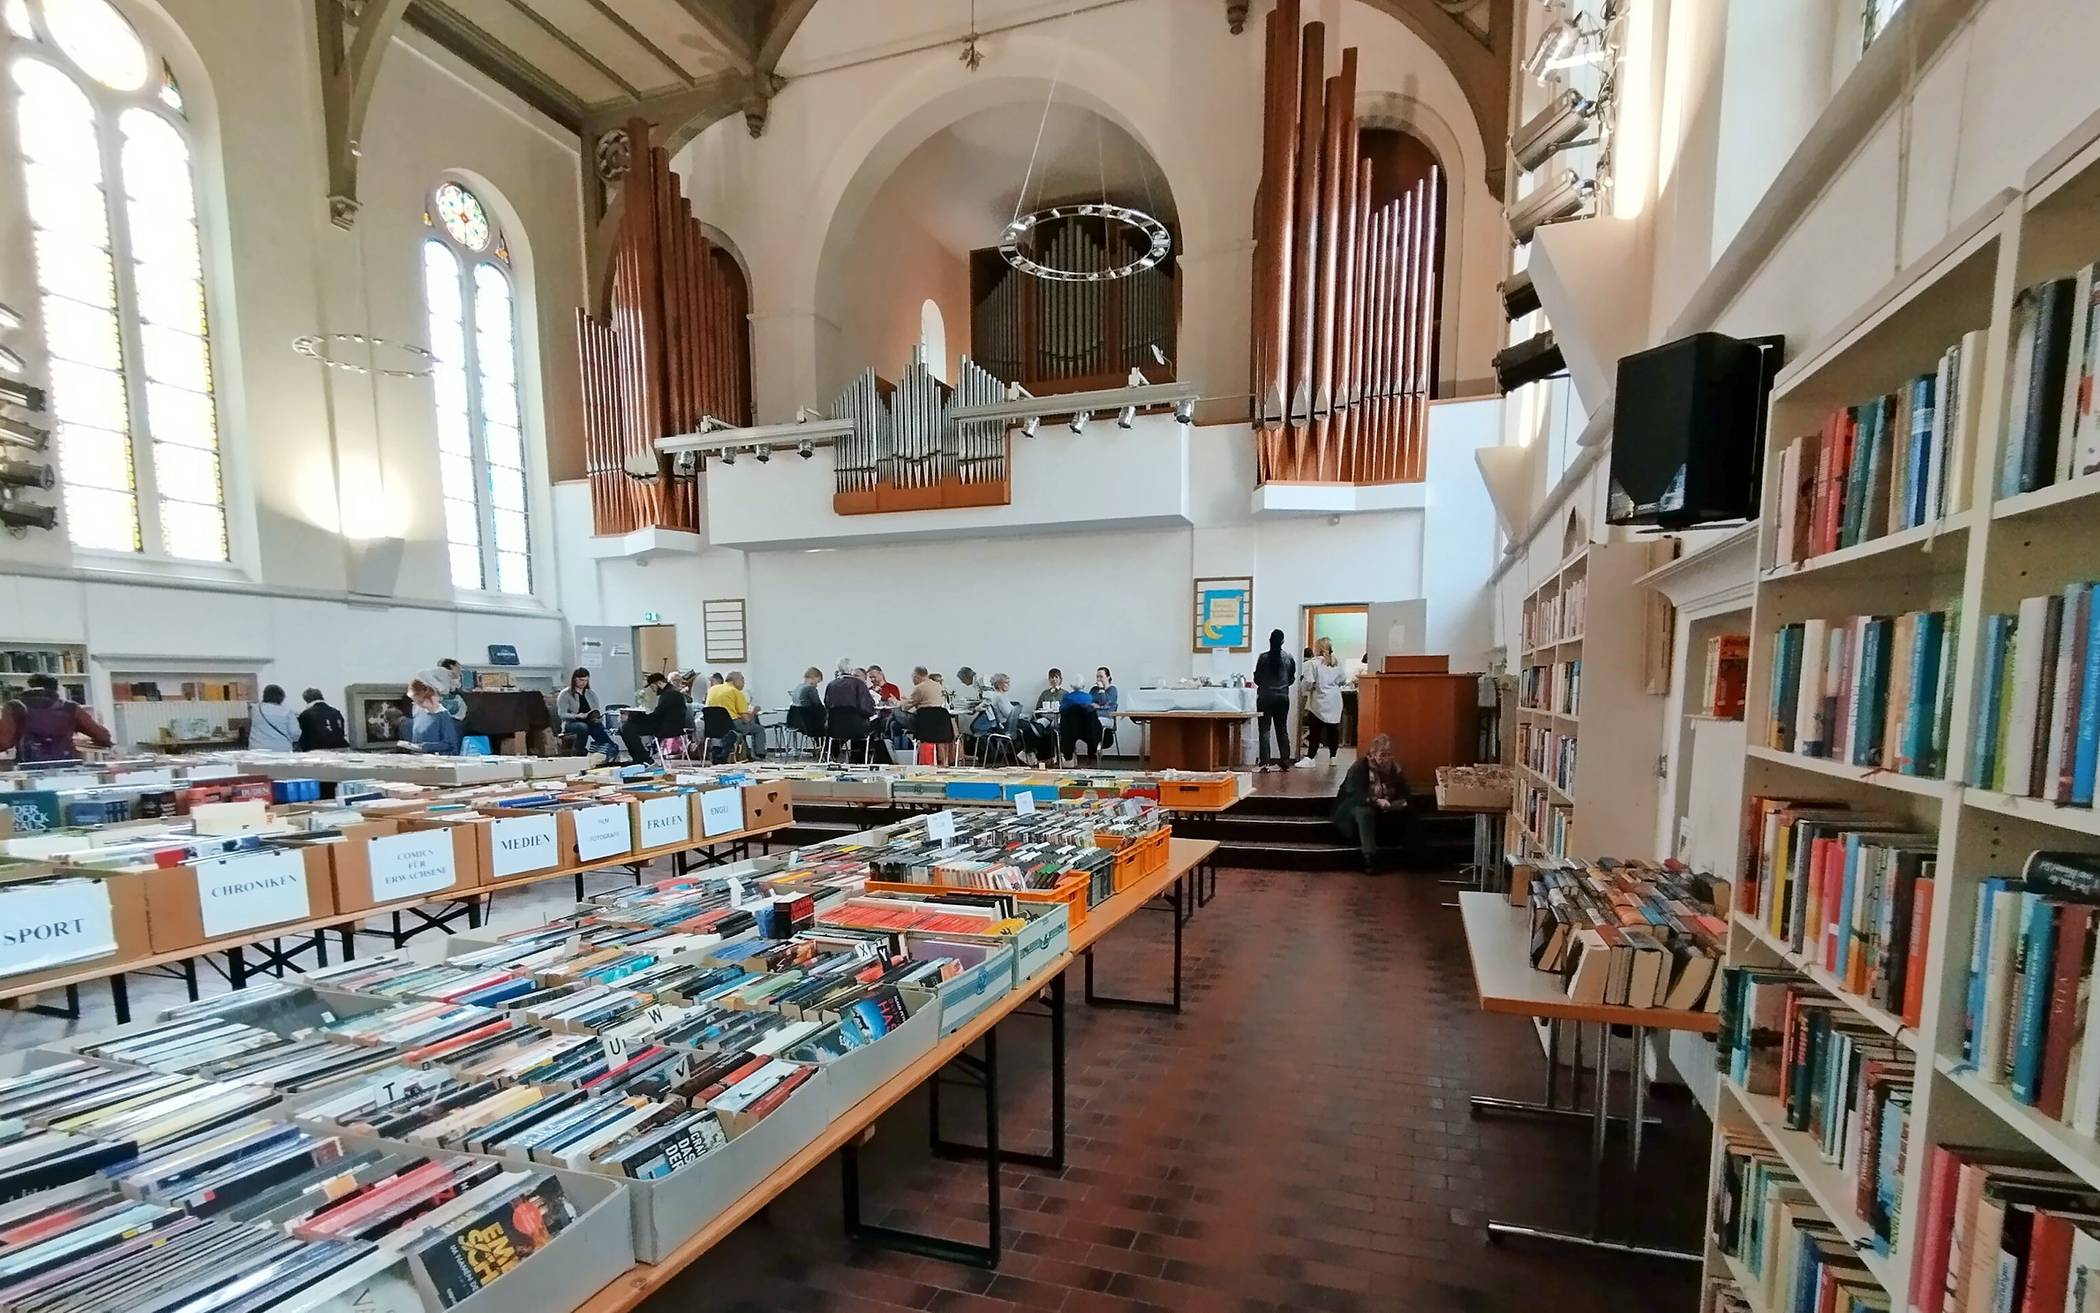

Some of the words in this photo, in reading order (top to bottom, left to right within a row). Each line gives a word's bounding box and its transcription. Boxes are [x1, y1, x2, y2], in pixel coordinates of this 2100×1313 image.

[648, 815, 683, 829] FRAUEN
[501, 833, 551, 850] MEDIEN
[397, 849, 434, 861] COMICS
[385, 866, 446, 884] ERWACHSENE
[211, 874, 298, 898] CHRONIKEN
[3, 918, 85, 945] SPORT
[858, 944, 868, 957] X
[879, 947, 888, 962] Y
[648, 1007, 663, 1024] W
[609, 1038, 621, 1055] U
[675, 1059, 685, 1078] V
[382, 1082, 395, 1101] T
[678, 1137, 696, 1166] DAS
